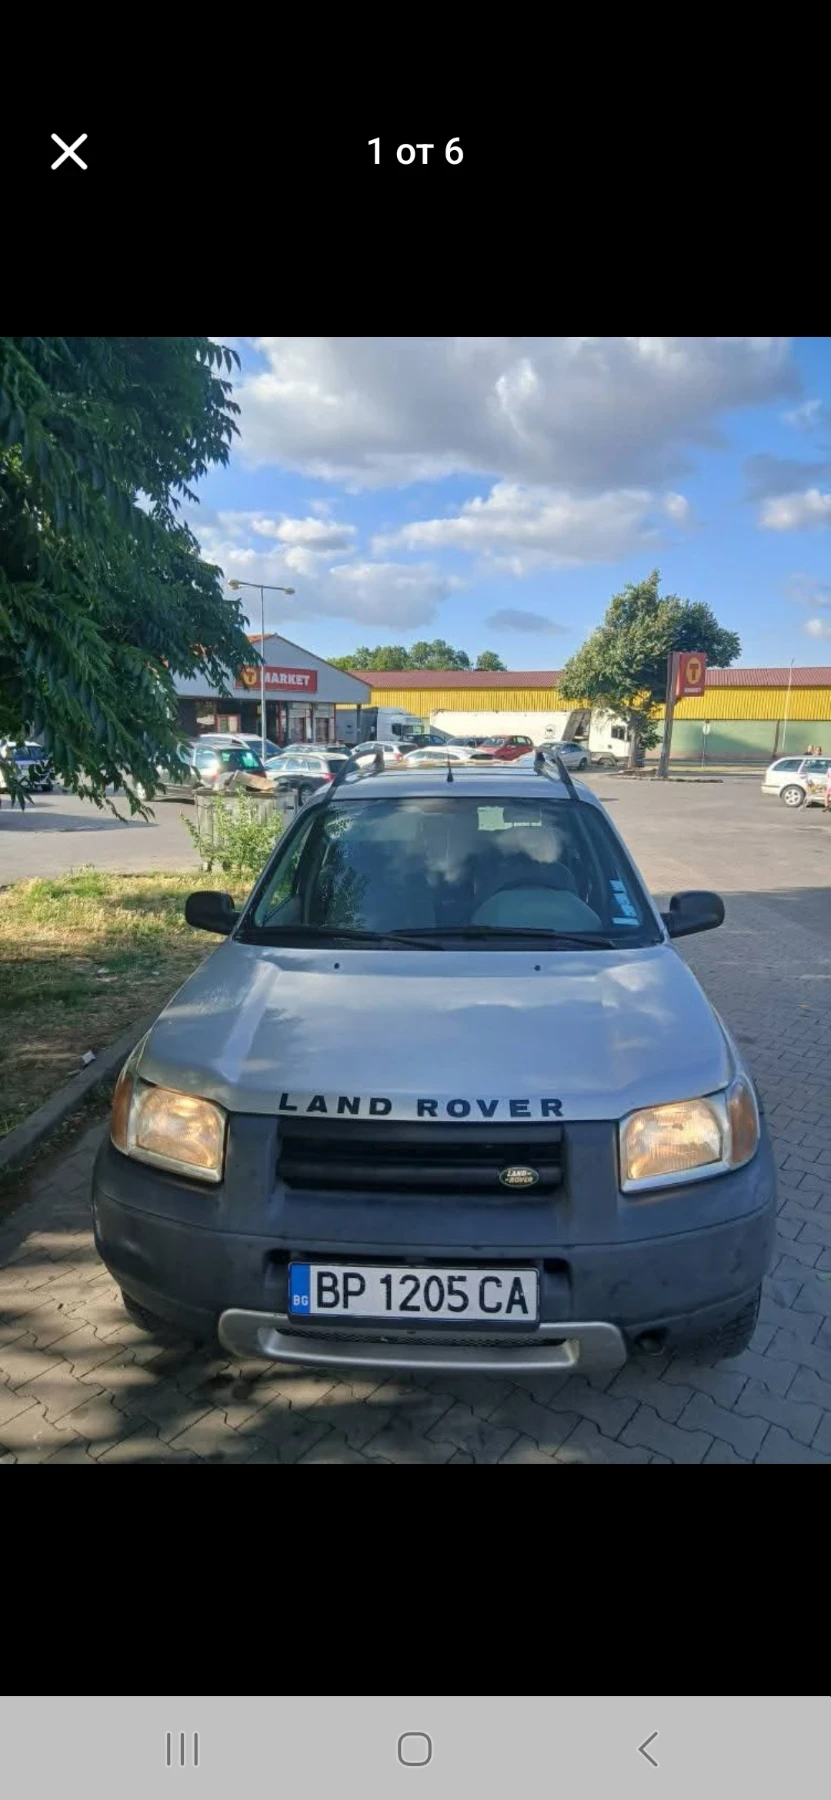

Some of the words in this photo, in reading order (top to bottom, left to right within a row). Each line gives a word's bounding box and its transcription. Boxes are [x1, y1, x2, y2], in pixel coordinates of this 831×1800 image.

[264, 672, 310, 686] MARKET
[689, 663, 699, 681] T
[279, 1093, 392, 1116] LAND
[417, 1098, 564, 1118] ROVER
[293, 1295, 309, 1306] BG
[317, 1271, 366, 1309] BP
[380, 1274, 469, 1313] 1205
[479, 1276, 529, 1314] CA
